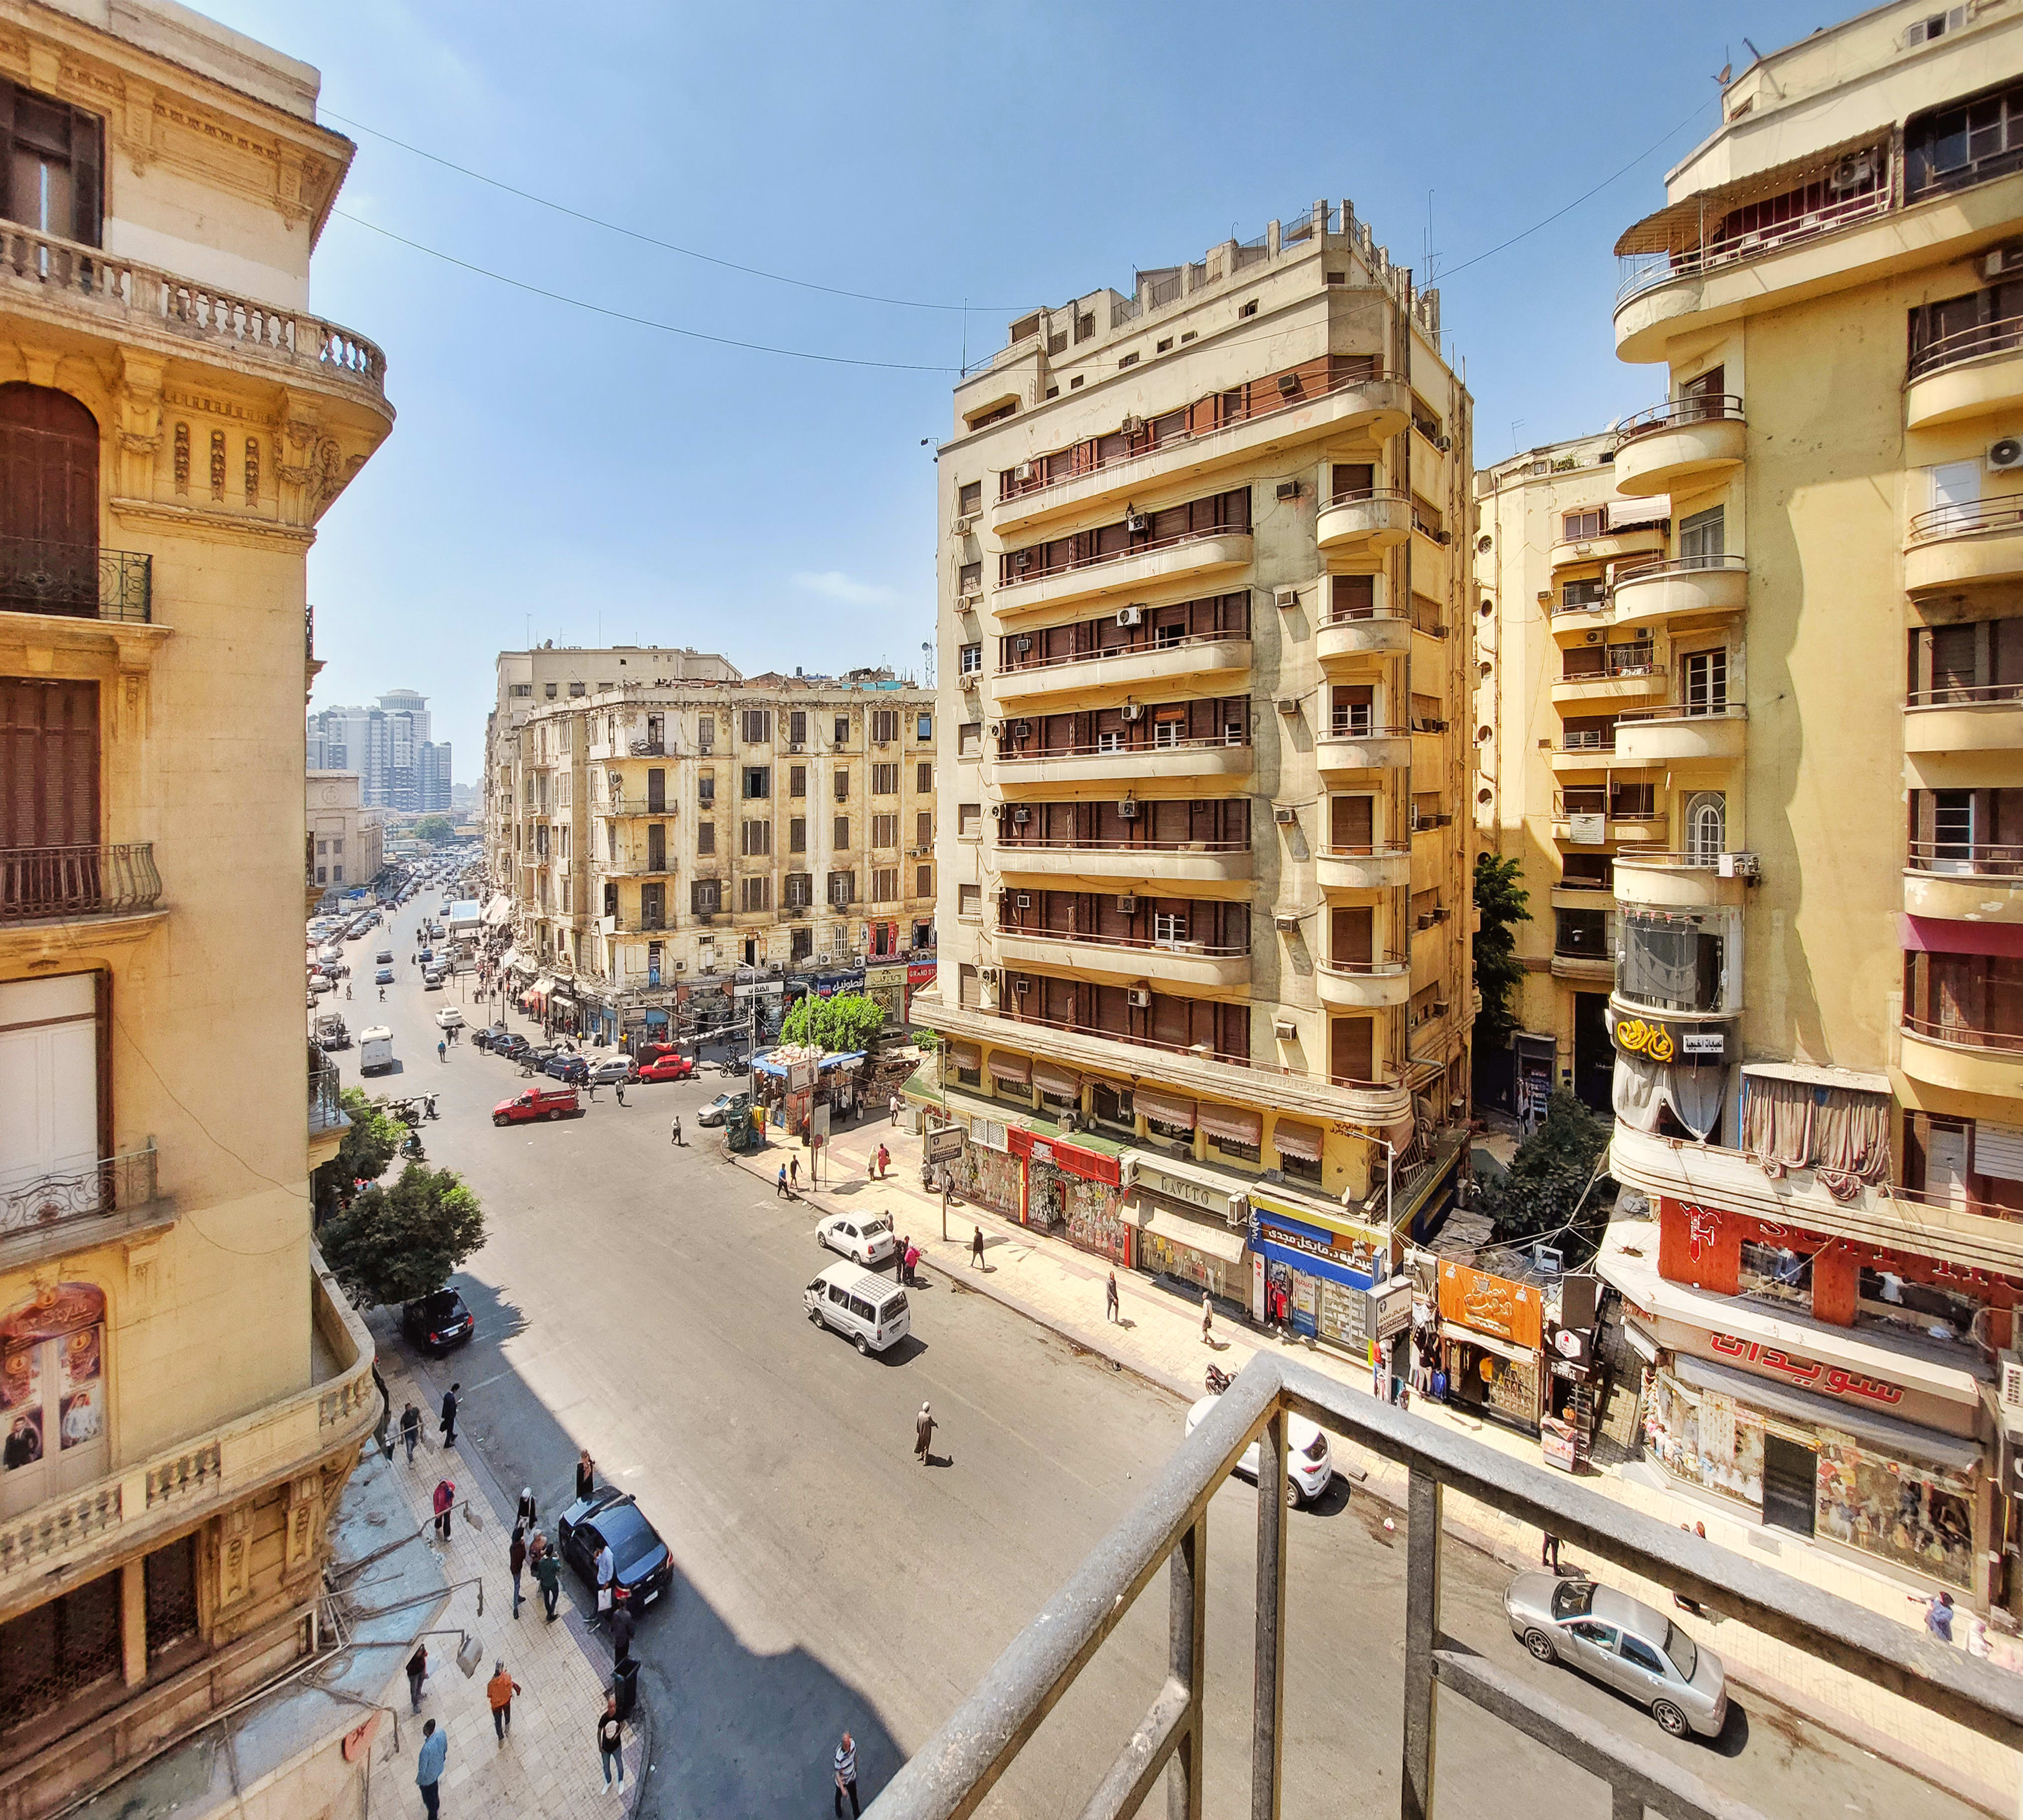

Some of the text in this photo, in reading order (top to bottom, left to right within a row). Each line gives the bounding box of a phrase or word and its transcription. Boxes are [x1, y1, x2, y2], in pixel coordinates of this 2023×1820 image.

[832, 978, 864, 991] قطونيل
[1161, 1176, 1210, 1205] LAVITO
[1297, 1236, 1329, 1255] مايكل
[1710, 1334, 1904, 1405] سويدان
